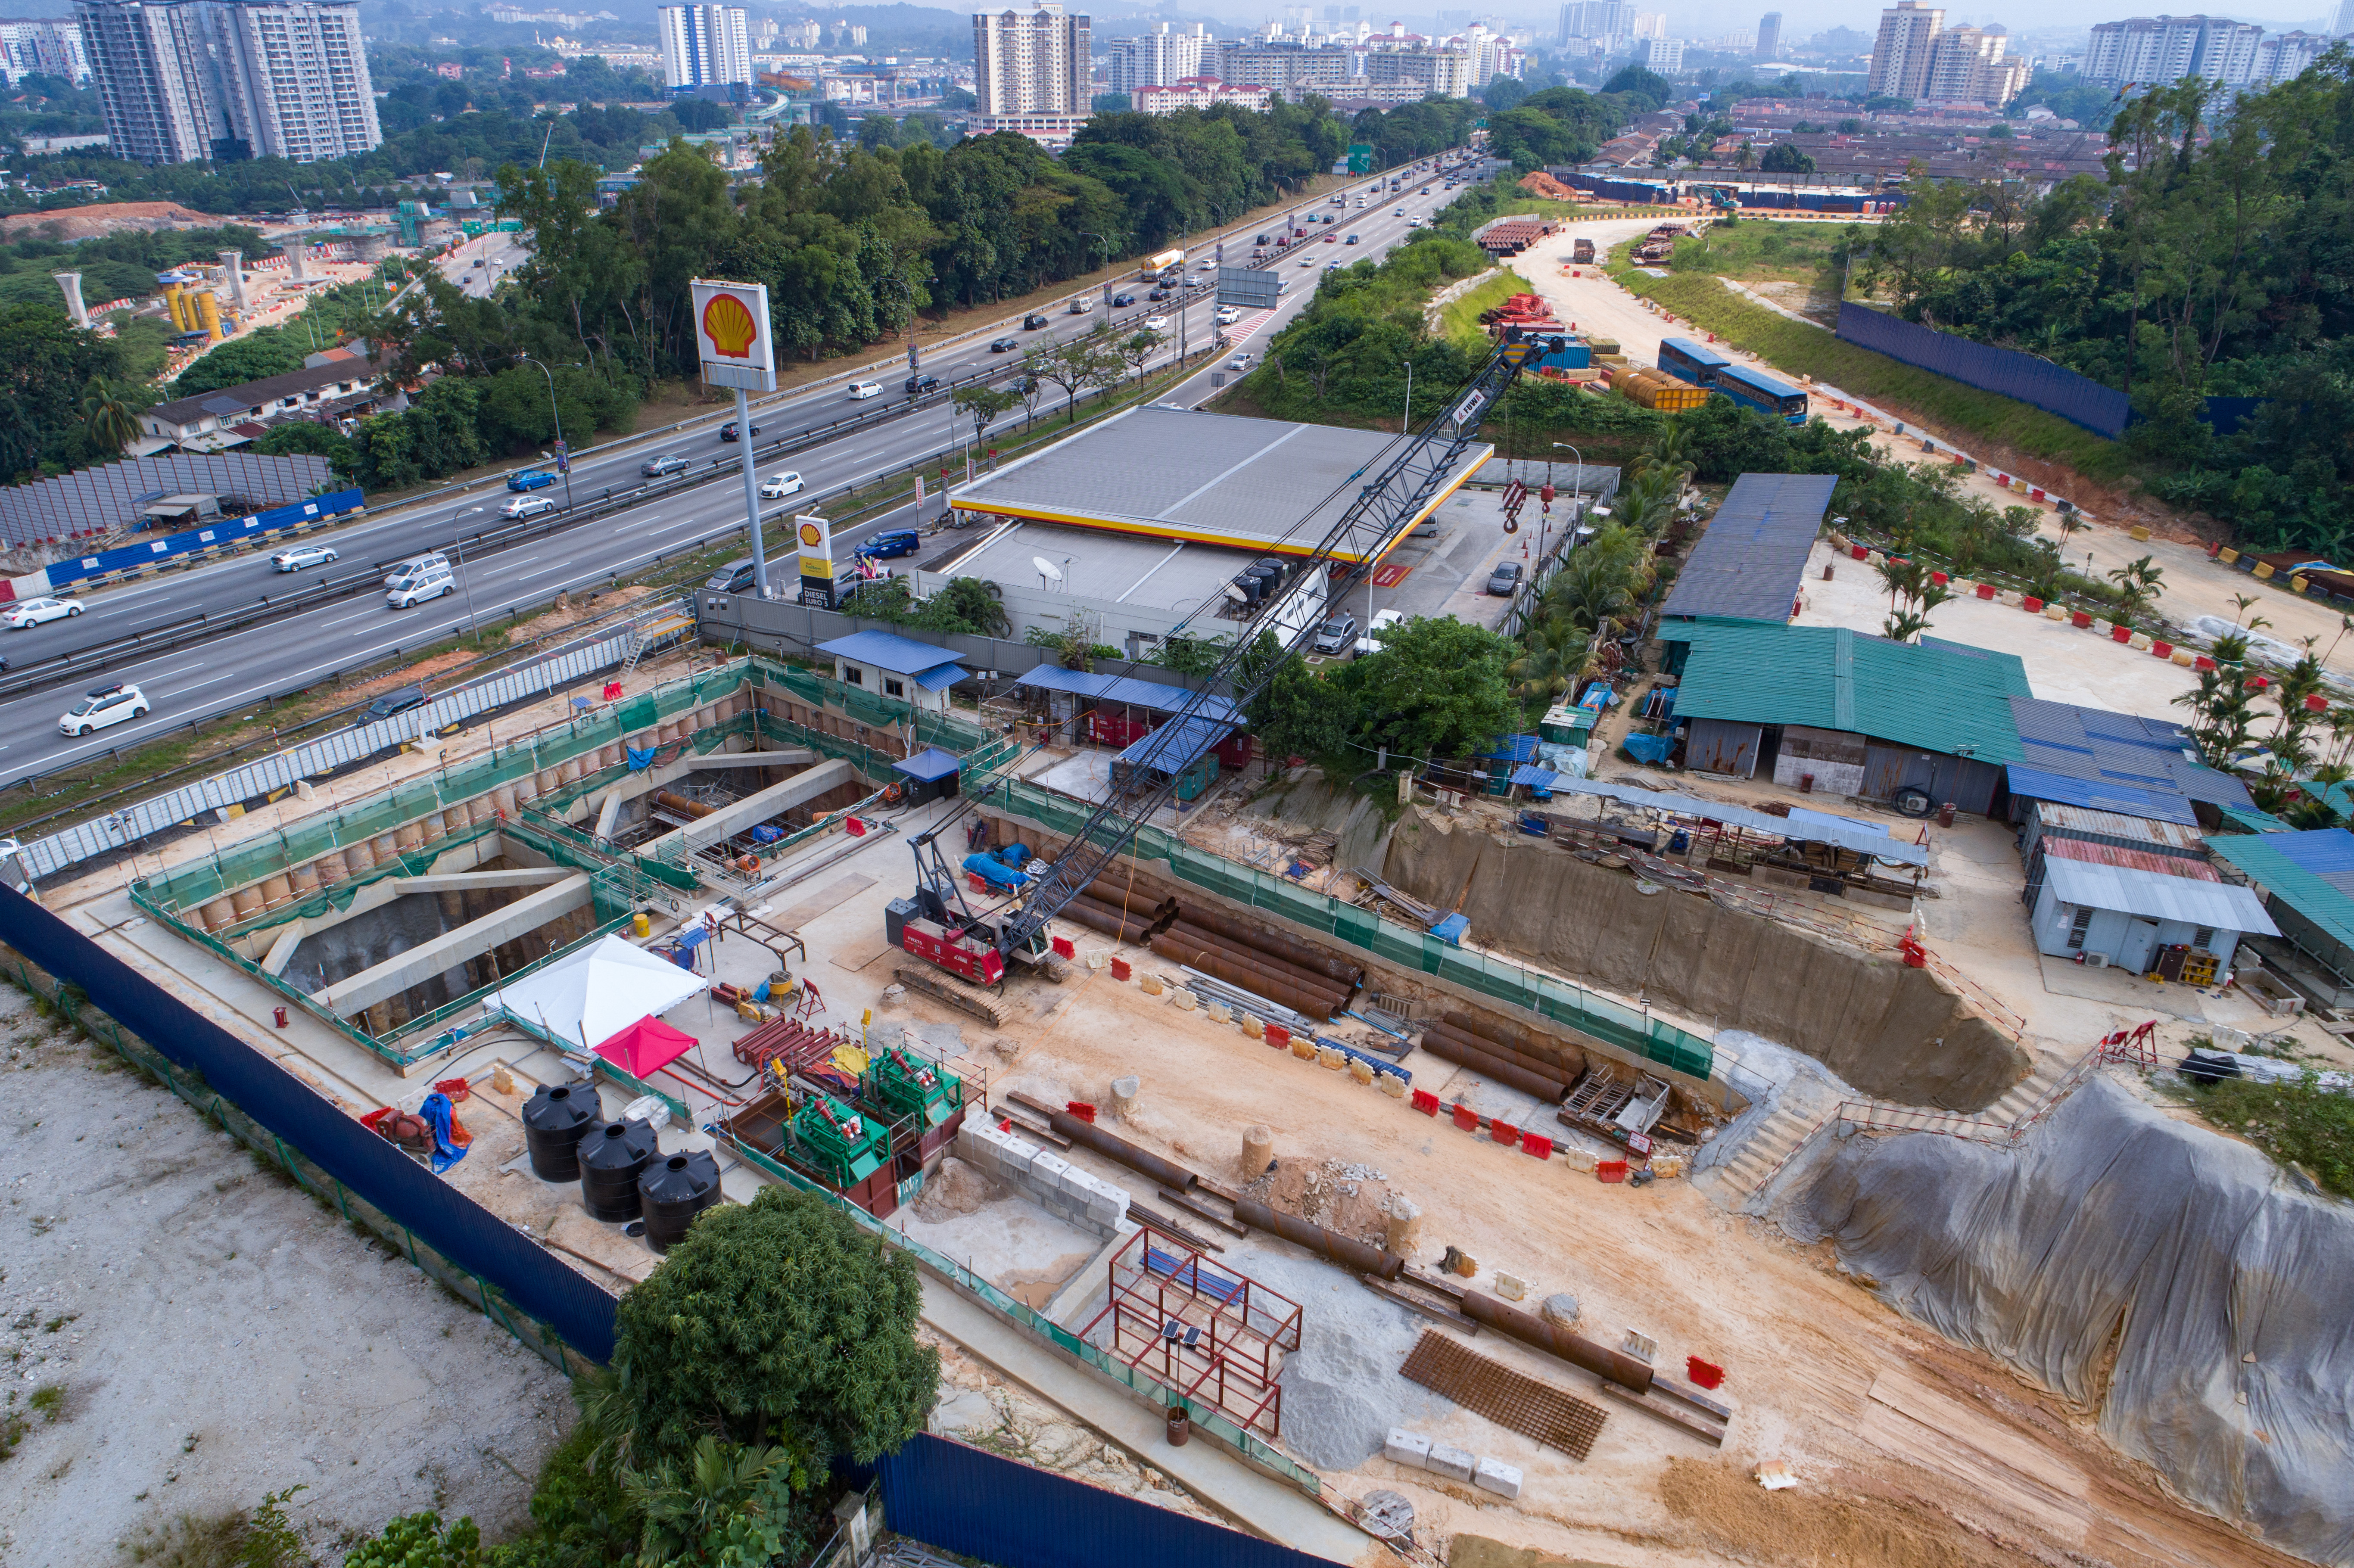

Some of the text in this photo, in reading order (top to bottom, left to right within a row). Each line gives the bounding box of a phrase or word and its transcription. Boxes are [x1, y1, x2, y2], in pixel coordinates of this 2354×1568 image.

[1463, 394, 1482, 414] FUWA
[804, 590, 828, 600] DIESEL
[908, 936, 922, 945] FWX75
